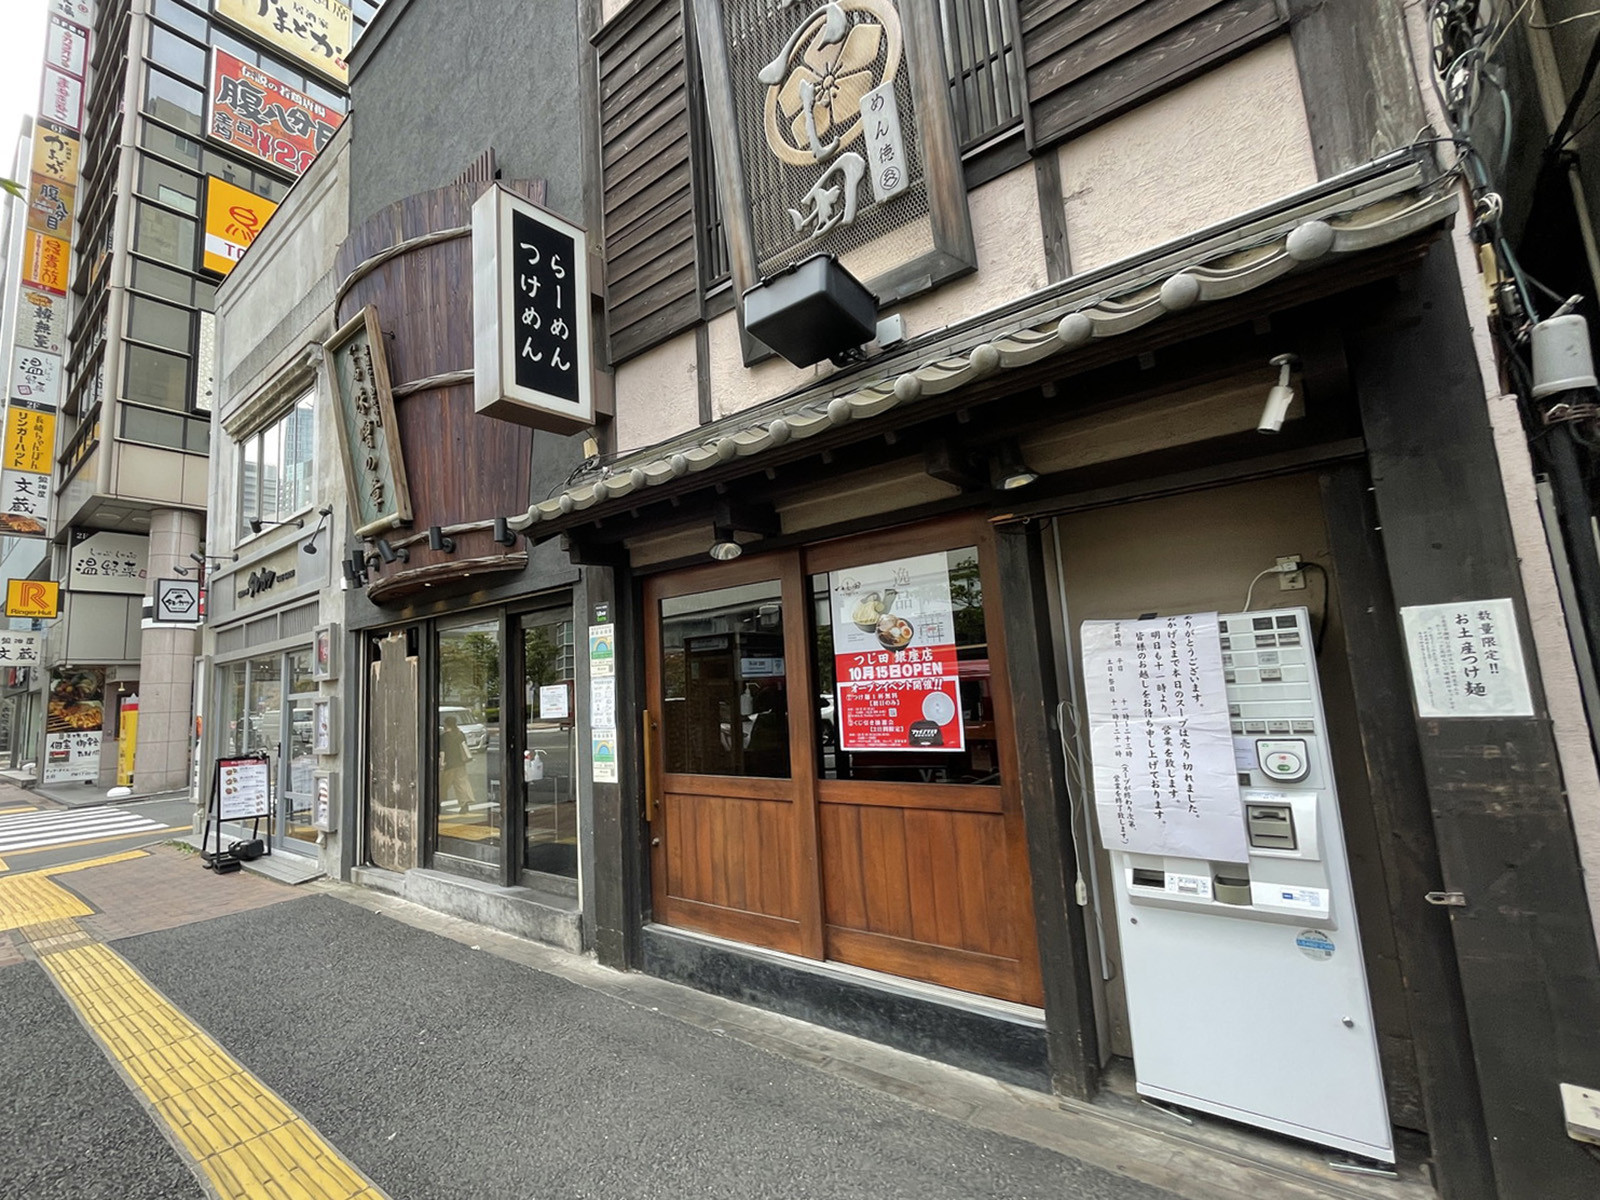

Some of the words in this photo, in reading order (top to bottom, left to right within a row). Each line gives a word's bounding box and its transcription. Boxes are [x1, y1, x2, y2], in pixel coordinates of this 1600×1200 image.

[519, 242, 543, 362] つけめん
[550, 254, 571, 371] らーめん
[14, 411, 28, 467] リンガーハット
[8, 477, 37, 514] 文蔵
[848, 661, 943, 681] 10月15日OPEN
[854, 652, 889, 665] つじ田
[895, 647, 933, 663] 銀座店
[1455, 613, 1488, 697] お土産つけ麺
[1477, 610, 1500, 675] 数量限定!!
